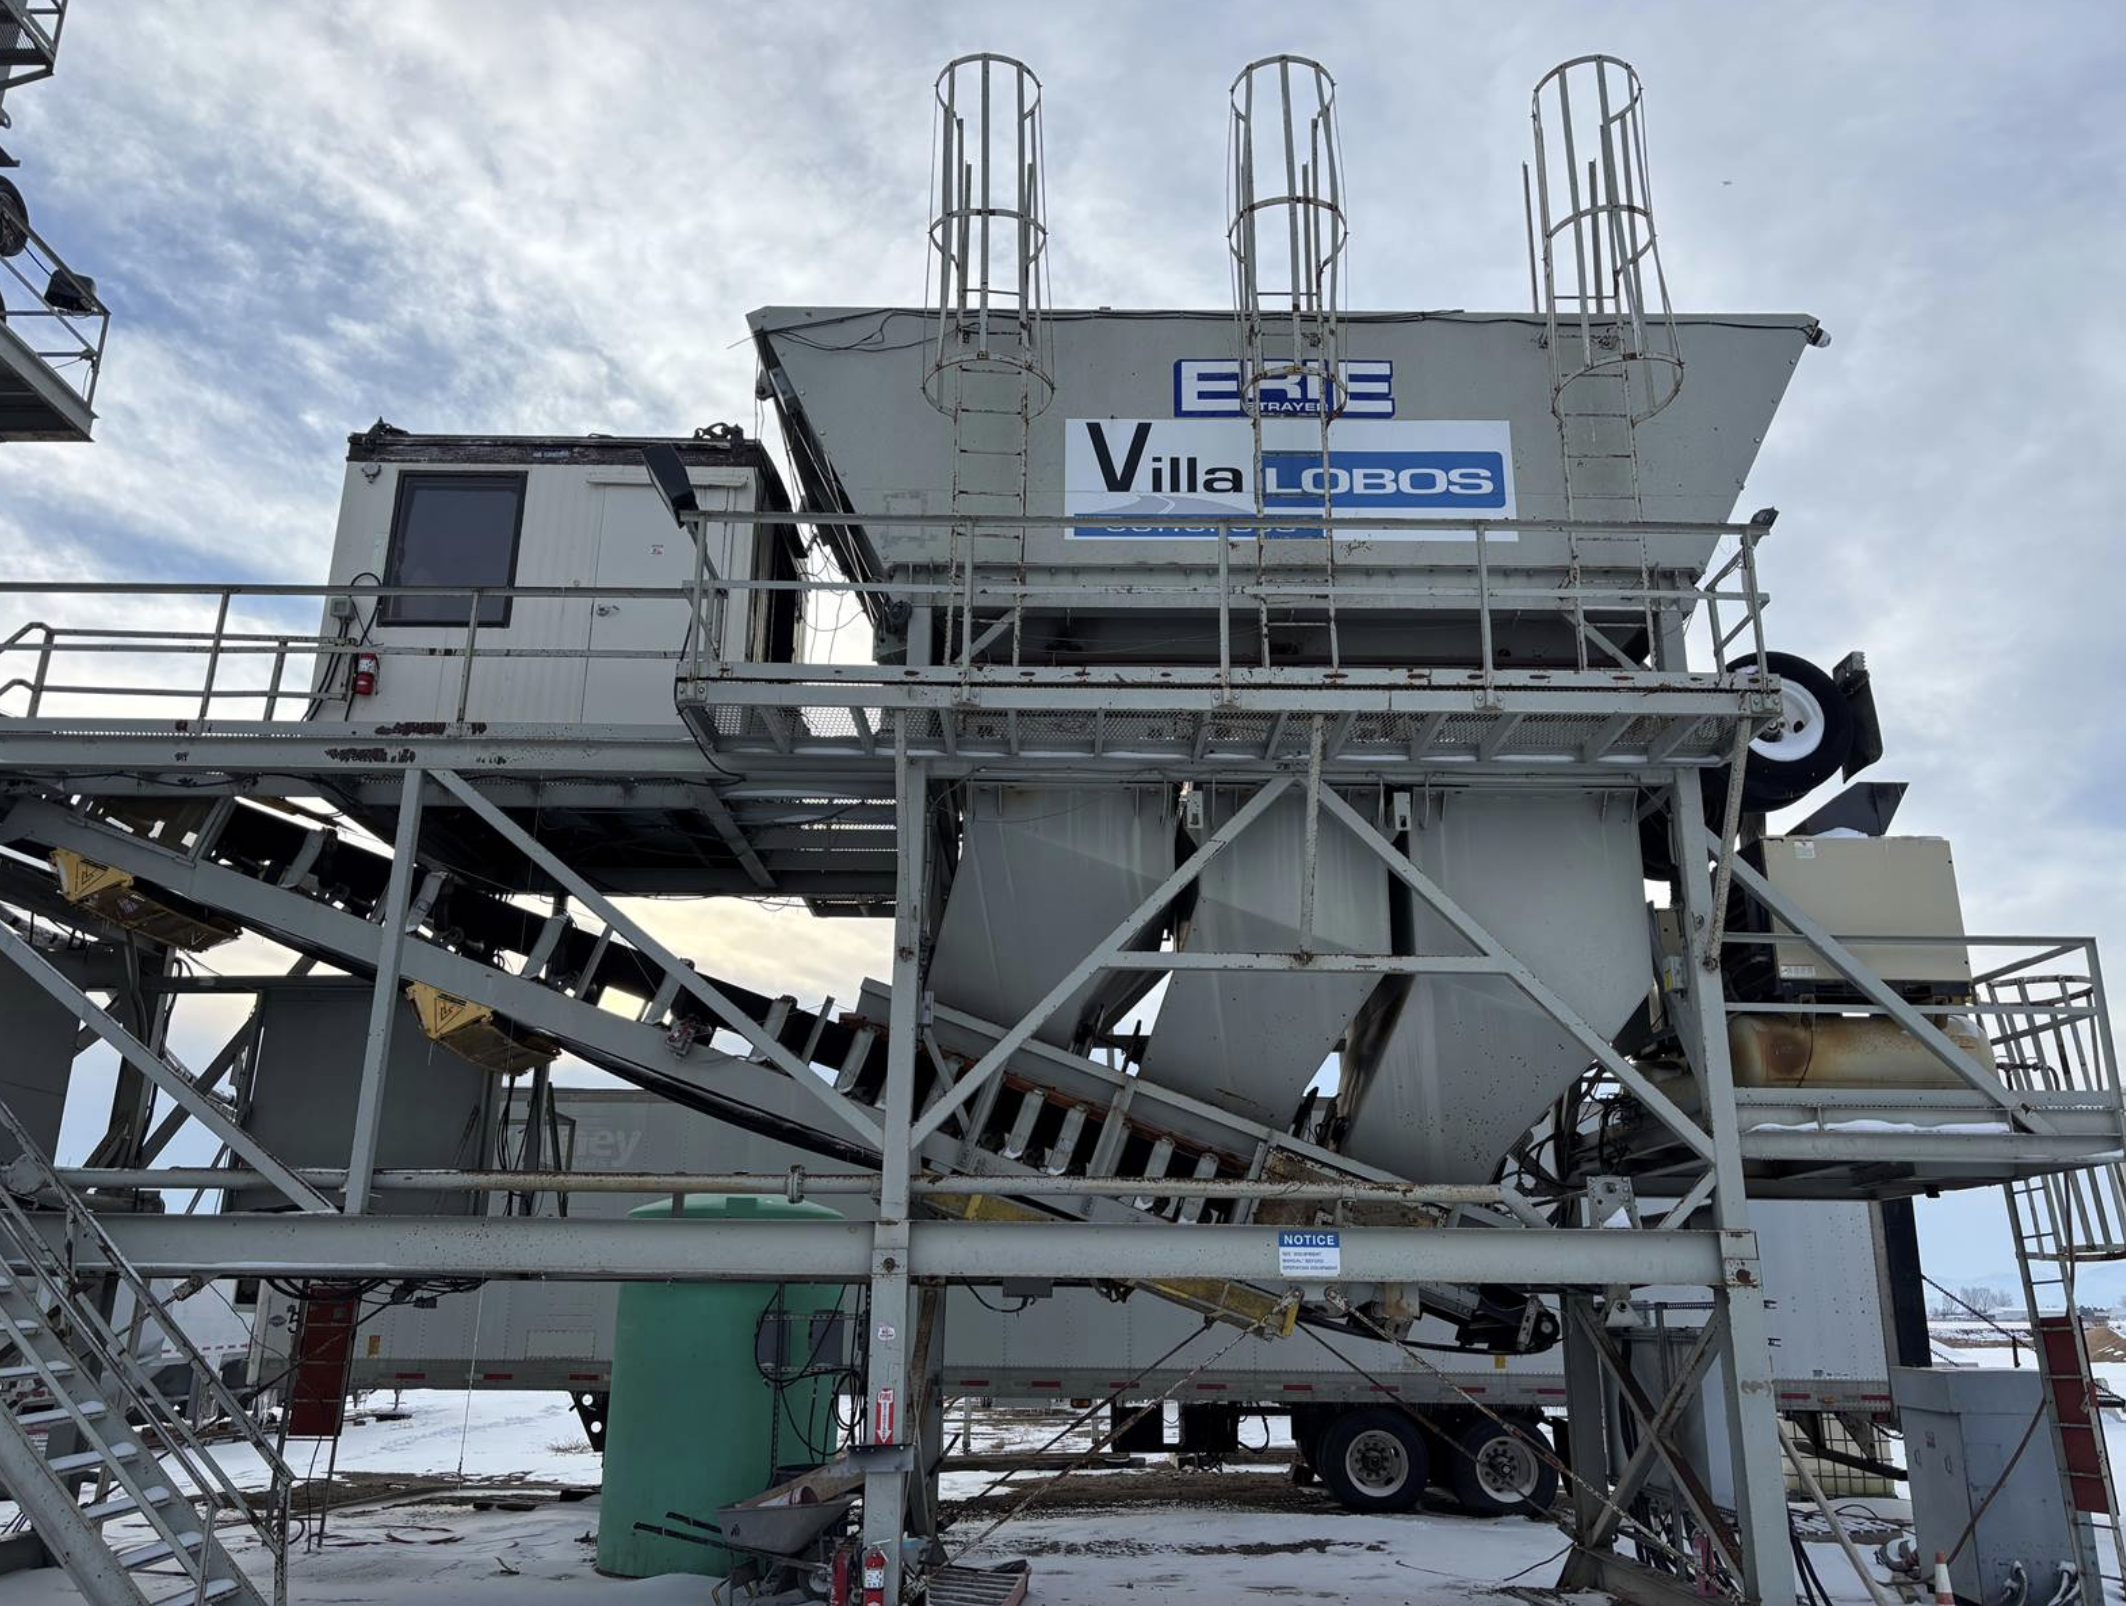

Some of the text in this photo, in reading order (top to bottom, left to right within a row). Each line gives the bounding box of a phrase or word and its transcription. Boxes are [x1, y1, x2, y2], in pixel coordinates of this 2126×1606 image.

[1181, 360, 1395, 413] ERIE
[1086, 422, 1495, 496] Villa LOBOS
[1283, 1234, 1336, 1246] NOTICE
